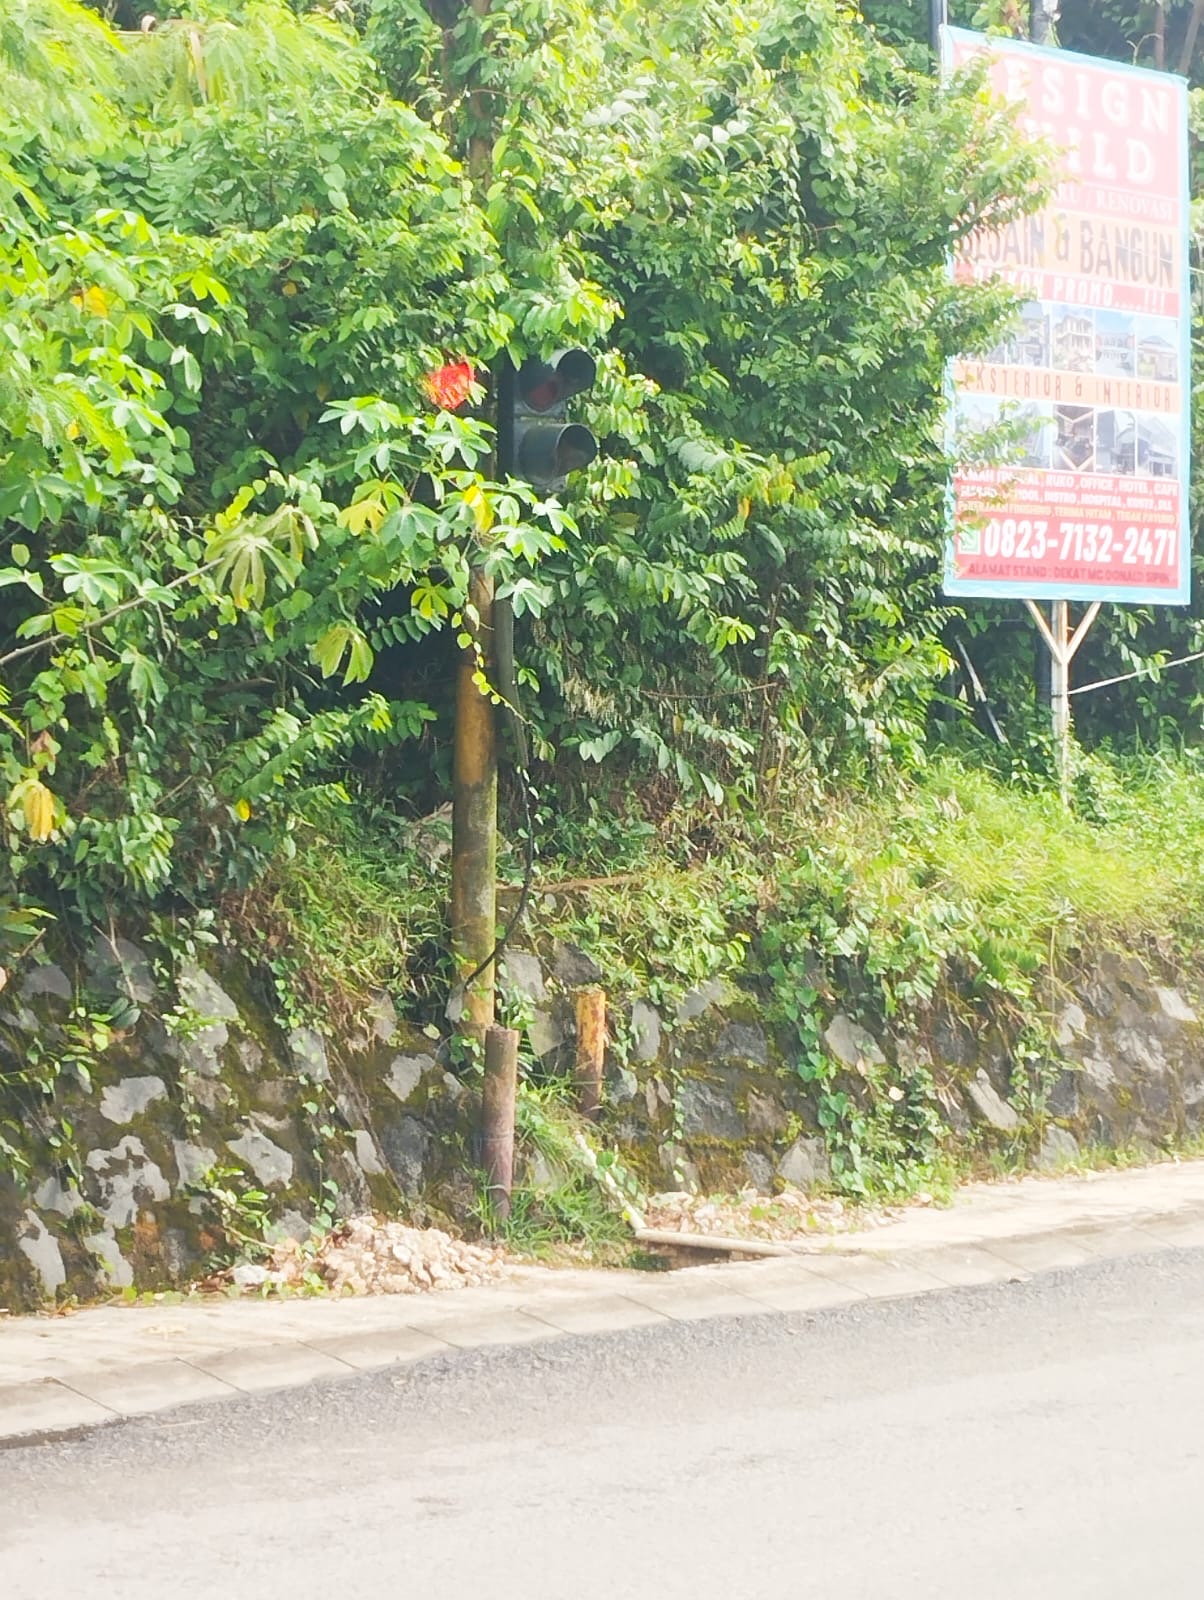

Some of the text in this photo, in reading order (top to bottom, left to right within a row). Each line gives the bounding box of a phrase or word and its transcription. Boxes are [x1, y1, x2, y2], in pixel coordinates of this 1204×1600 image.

[957, 48, 1170, 135] ESIGN
[1079, 219, 1174, 289] BANGUN
[984, 518, 1177, 566] 0823-7132-2471
[968, 563, 1010, 576] ALAMAT
[1054, 566, 1086, 580] DEKAT
[1088, 568, 1103, 581] MC
